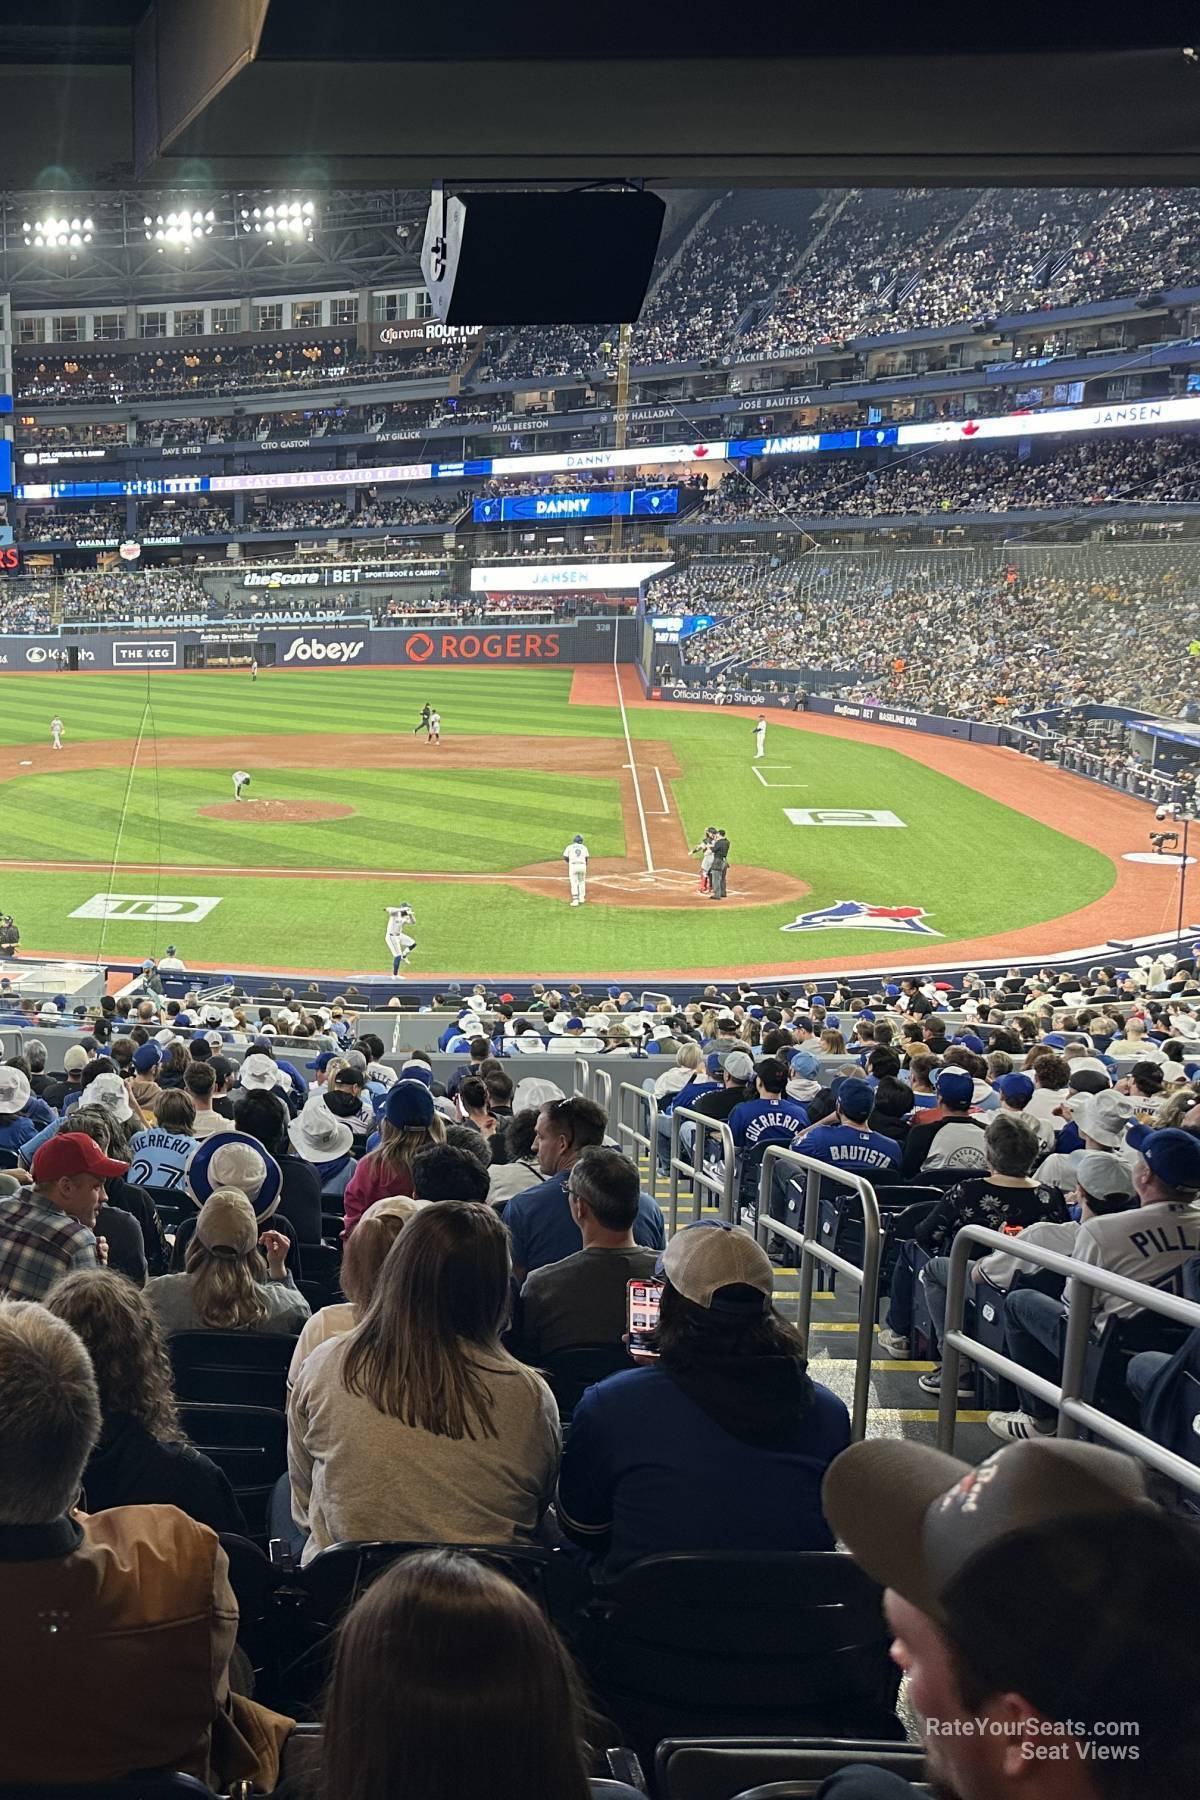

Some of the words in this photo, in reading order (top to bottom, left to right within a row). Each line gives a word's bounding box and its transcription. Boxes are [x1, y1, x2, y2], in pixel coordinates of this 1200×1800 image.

[380, 327, 424, 344] Corona
[441, 336, 467, 345] PATIO
[734, 352, 765, 364] JACKIE
[766, 346, 814, 361] ROBINSON
[766, 395, 811, 408] BAUTISTA
[612, 413, 630, 422] ROY
[631, 408, 675, 420] HALLADAY
[1093, 406, 1162, 424] JANSEN
[492, 424, 512, 433] PAUL
[513, 420, 549, 431] BEESTON
[376, 433, 390, 442] PAT
[391, 431, 421, 441] GILLICK
[162, 447, 181, 456] DAVE
[182, 446, 202, 455] STIEB
[261, 442, 278, 450] CITO
[280, 440, 310, 449] GASTON
[762, 435, 821, 455] JANSEN
[566, 454, 612, 467] DANNY
[535, 499, 591, 514] DANNY
[76, 539, 104, 548] CANADA
[143, 536, 181, 545] BLEACHERS
[243, 571, 320, 587] theScore
[333, 569, 362, 584] BET
[365, 571, 408, 579] SPORTSBOOK
[414, 569, 440, 577] CASINO
[532, 571, 589, 585] JANSEN
[133, 613, 209, 628] BLEACHERS
[253, 611, 311, 624] CANADA
[120, 649, 143, 658] THE
[148, 649, 170, 658] KEG
[283, 637, 364, 662] Sobeys
[441, 634, 560, 658] ROGERS
[672, 689, 701, 700] Official
[734, 692, 765, 705] Shingle
[862, 709, 874, 719] BET
[879, 712, 904, 725] BASELINE
[104, 899, 199, 916] TD
[745, 1112, 800, 1142] GUERRERO
[132, 1134, 191, 1155] UERRERO
[829, 1145, 892, 1169] BAUTISTA
[132, 1159, 185, 1189] 27
[1128, 1225, 1200, 1258] PILL
